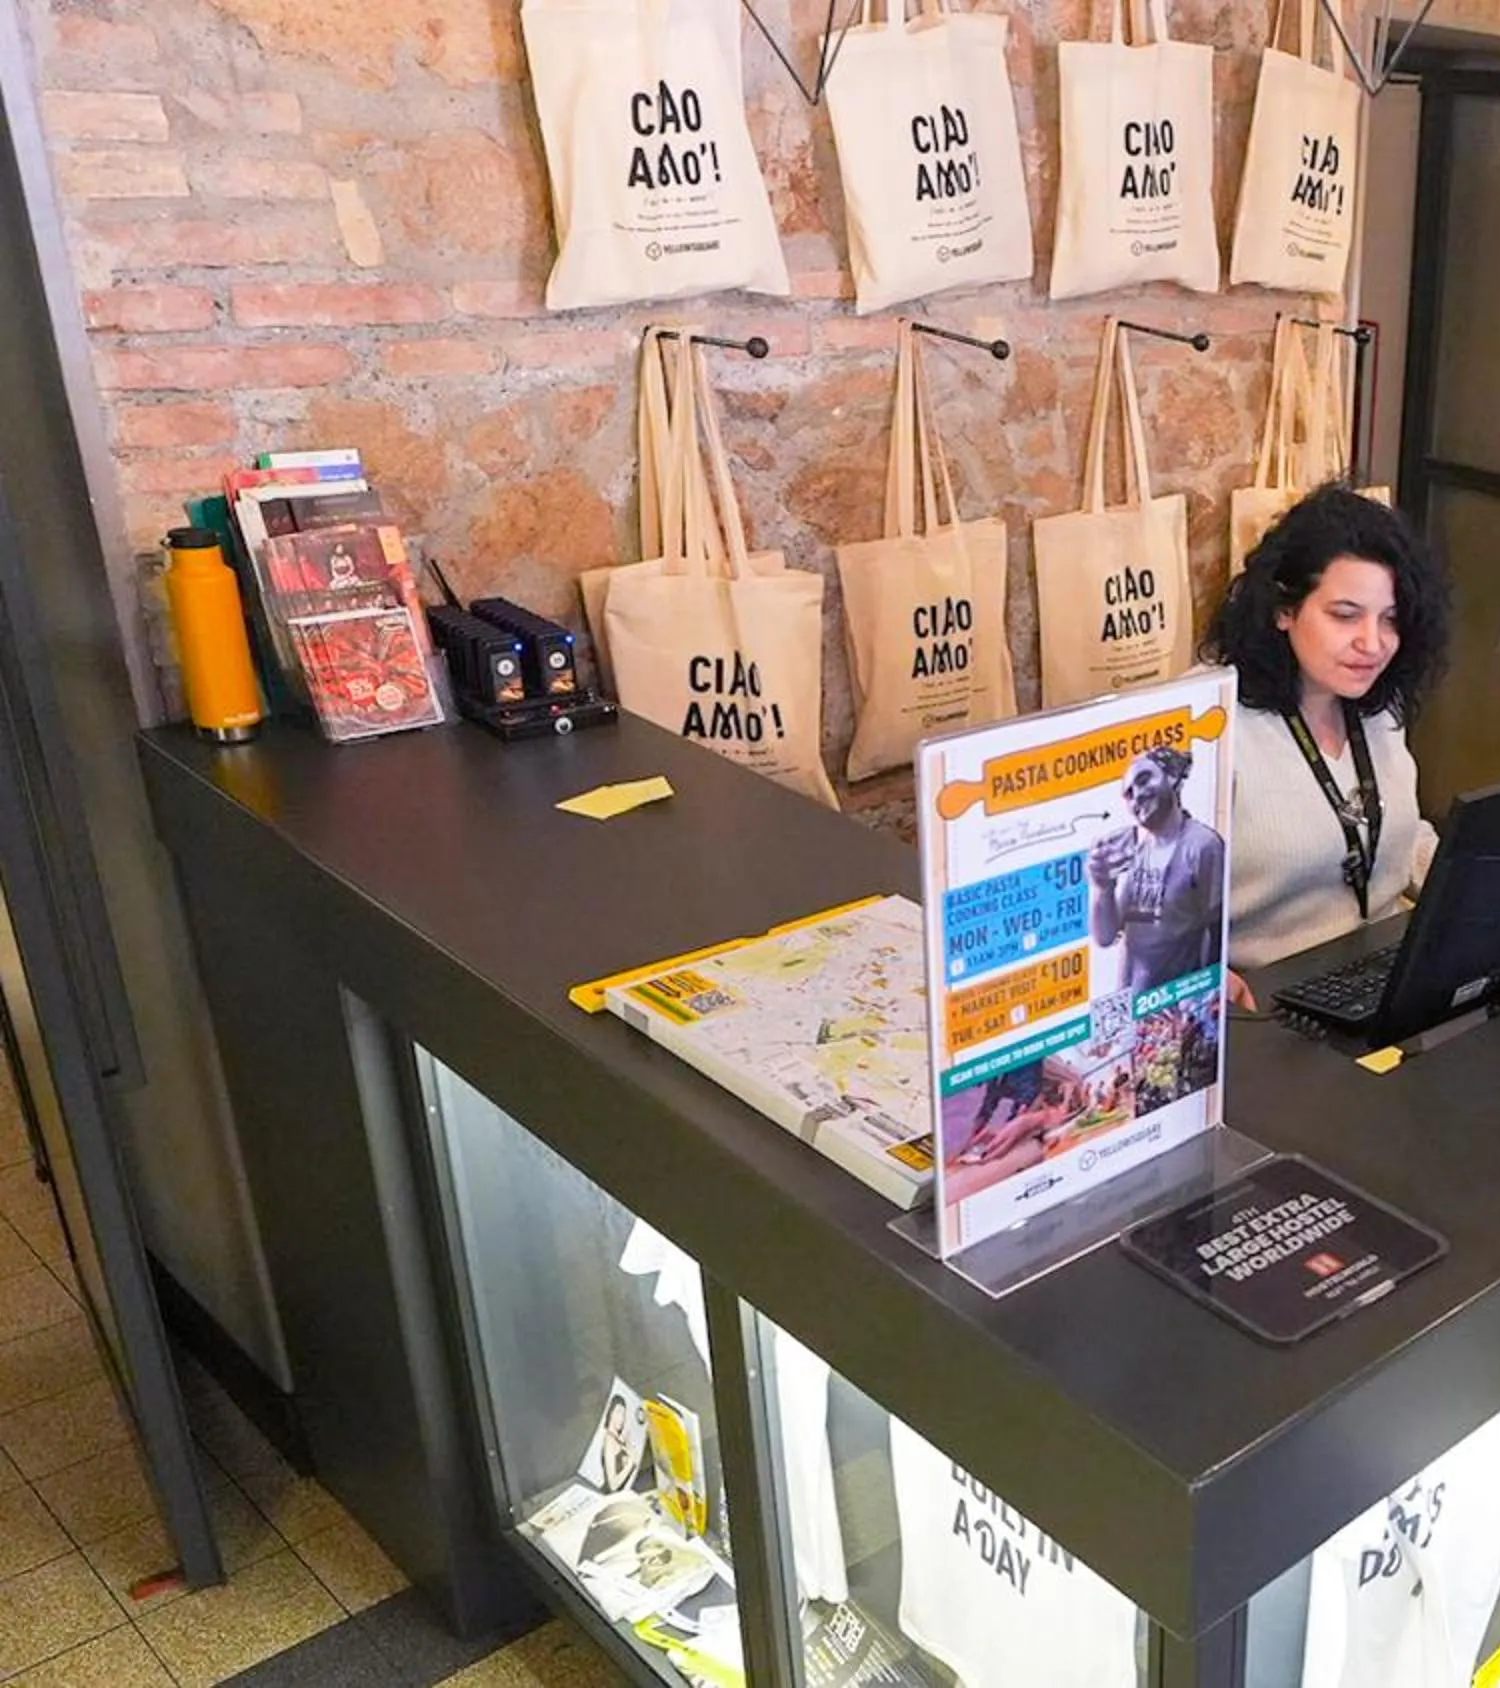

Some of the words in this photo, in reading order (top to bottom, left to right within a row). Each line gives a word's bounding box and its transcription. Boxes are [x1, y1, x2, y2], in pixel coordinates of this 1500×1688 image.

[631, 80, 702, 136] CAO
[1105, 565, 1155, 606] CIAO
[913, 595, 972, 639] CIAO
[1101, 601, 1165, 642] AMO'!
[690, 649, 761, 698] CIAO
[682, 701, 784, 742] AMO'!
[991, 764, 1048, 798] PASTA
[1053, 740, 1127, 779] COOKING
[1131, 722, 1184, 757] CLASS
[946, 886, 980, 908] BASIC
[984, 875, 1021, 897] PASTA
[947, 898, 998, 925] COOKING
[1001, 886, 1038, 910] CLASS
[949, 925, 988, 955] MON
[1002, 908, 1042, 938] WED
[1056, 895, 1082, 919] FRI
[960, 988, 1006, 1014] MARKET
[1009, 979, 1037, 1001] VISIT
[951, 1028, 973, 1046] TUE
[984, 1013, 1006, 1034] SAT
[1197, 1223, 1251, 1260] BEST
[1253, 1192, 1319, 1236] EXTRA
[1200, 1233, 1274, 1277] LARGE
[1270, 1197, 1349, 1244] HOSTEL
[1232, 1206, 1261, 1225] 4TH
[1226, 1209, 1356, 1282] WORLDWIDE
[953, 1498, 971, 1548] A
[974, 1519, 1031, 1597] DAY
